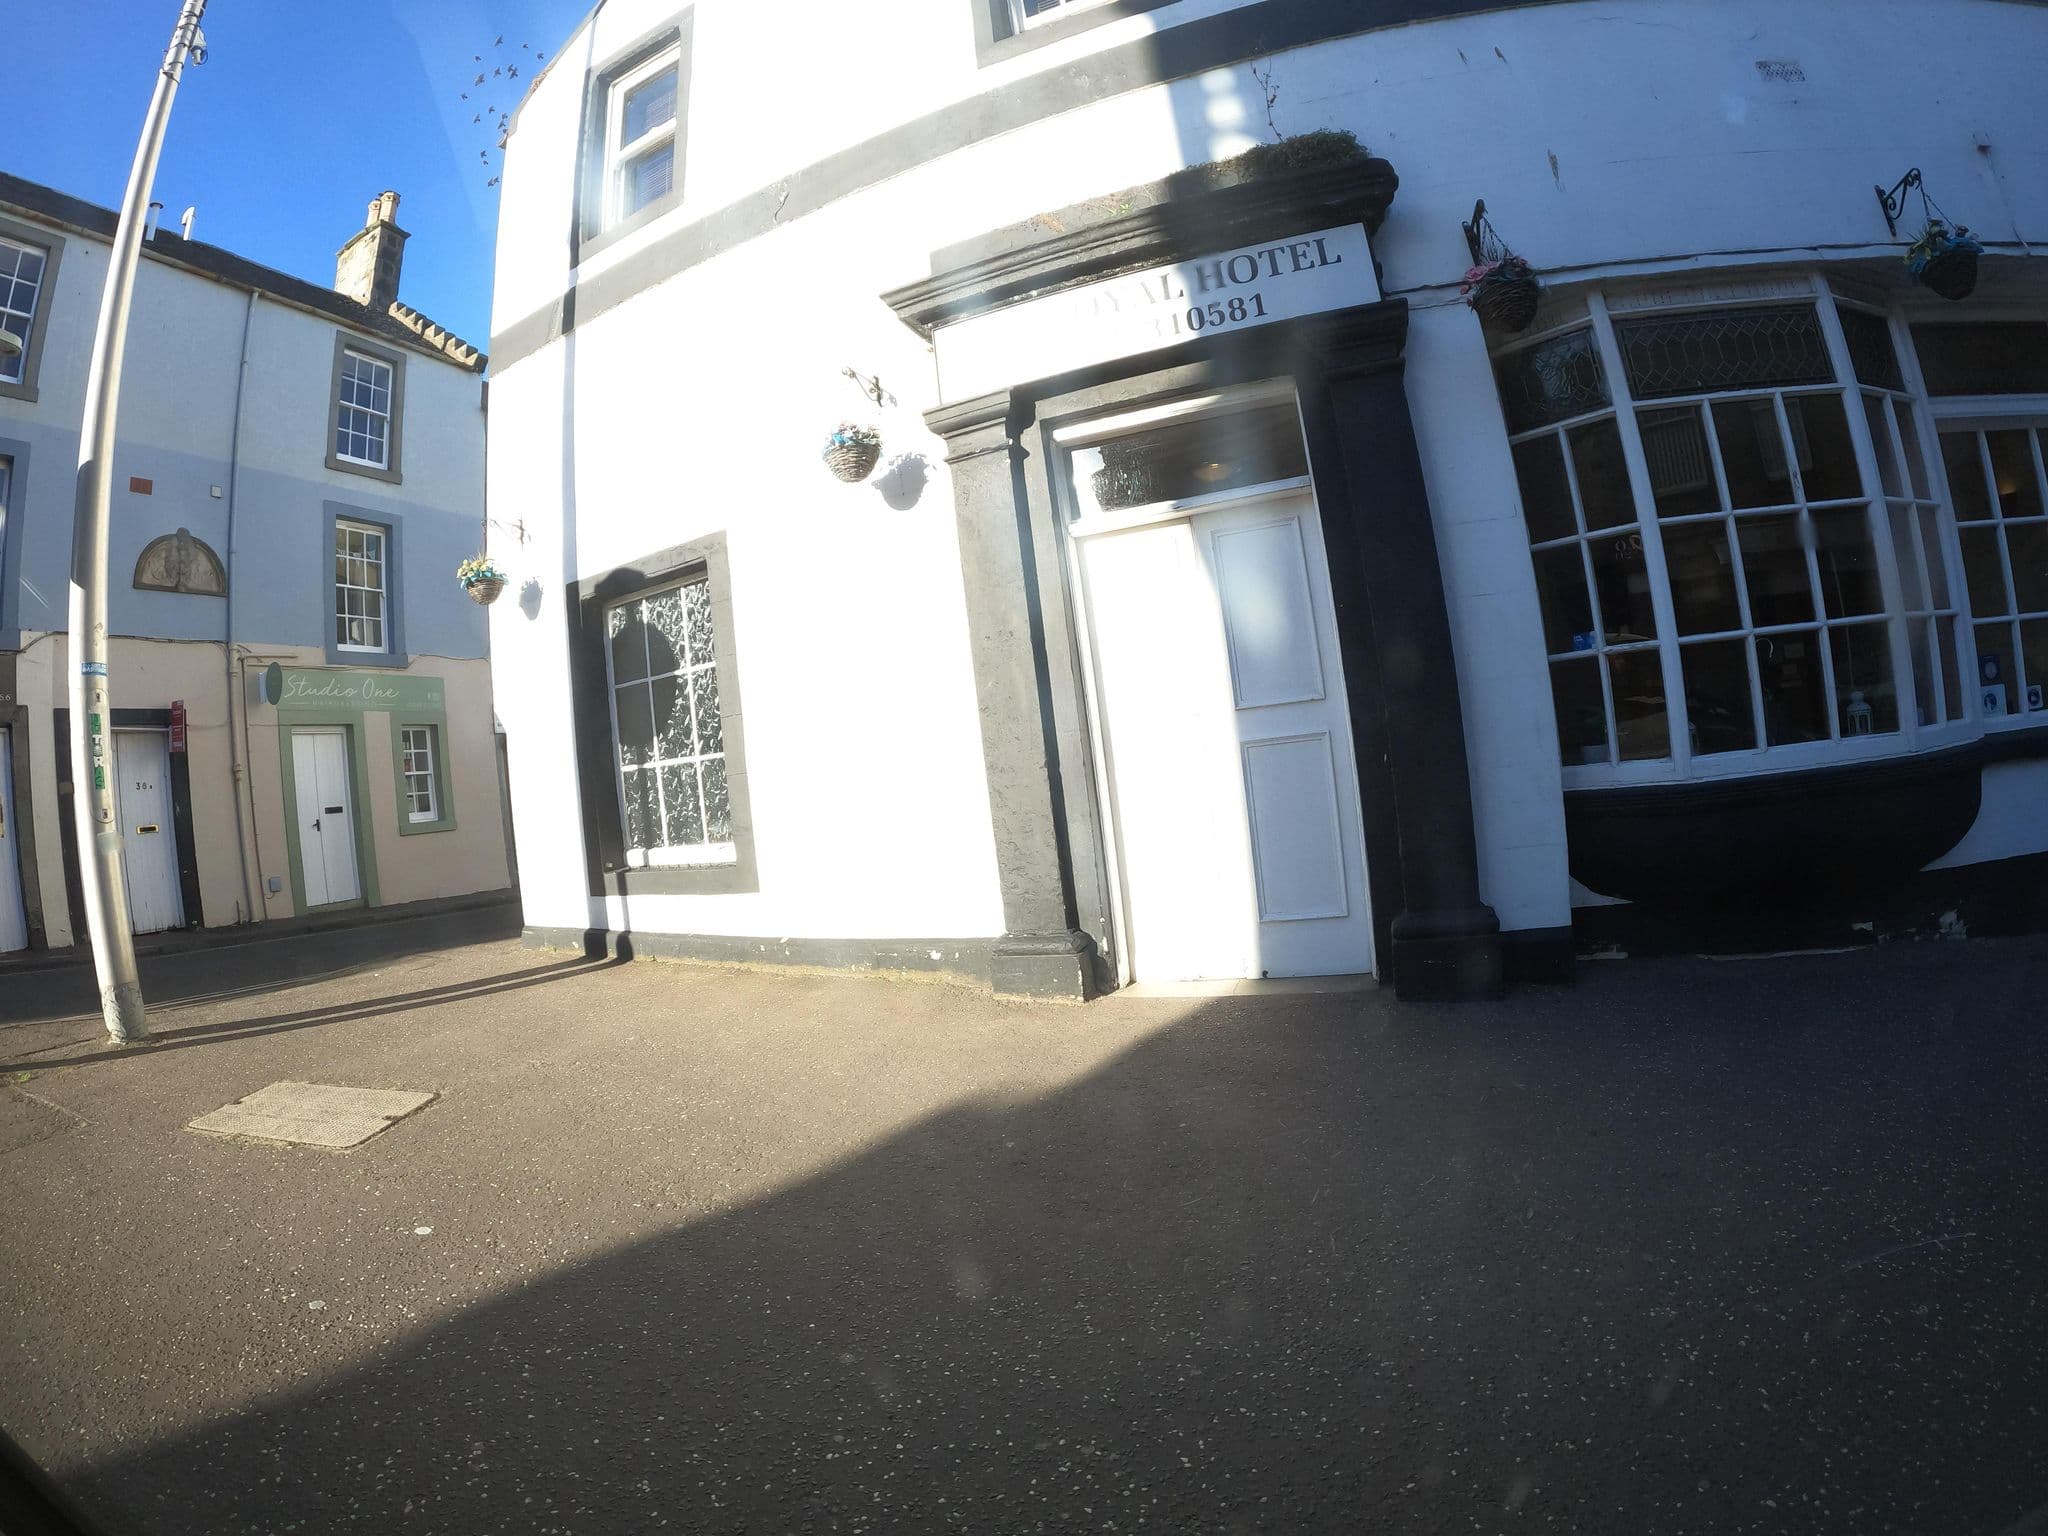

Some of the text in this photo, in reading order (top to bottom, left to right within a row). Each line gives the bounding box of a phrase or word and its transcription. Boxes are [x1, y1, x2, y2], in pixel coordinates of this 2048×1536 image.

[1195, 238, 1342, 293] HOTEL
[284, 674, 400, 700] Studio One
